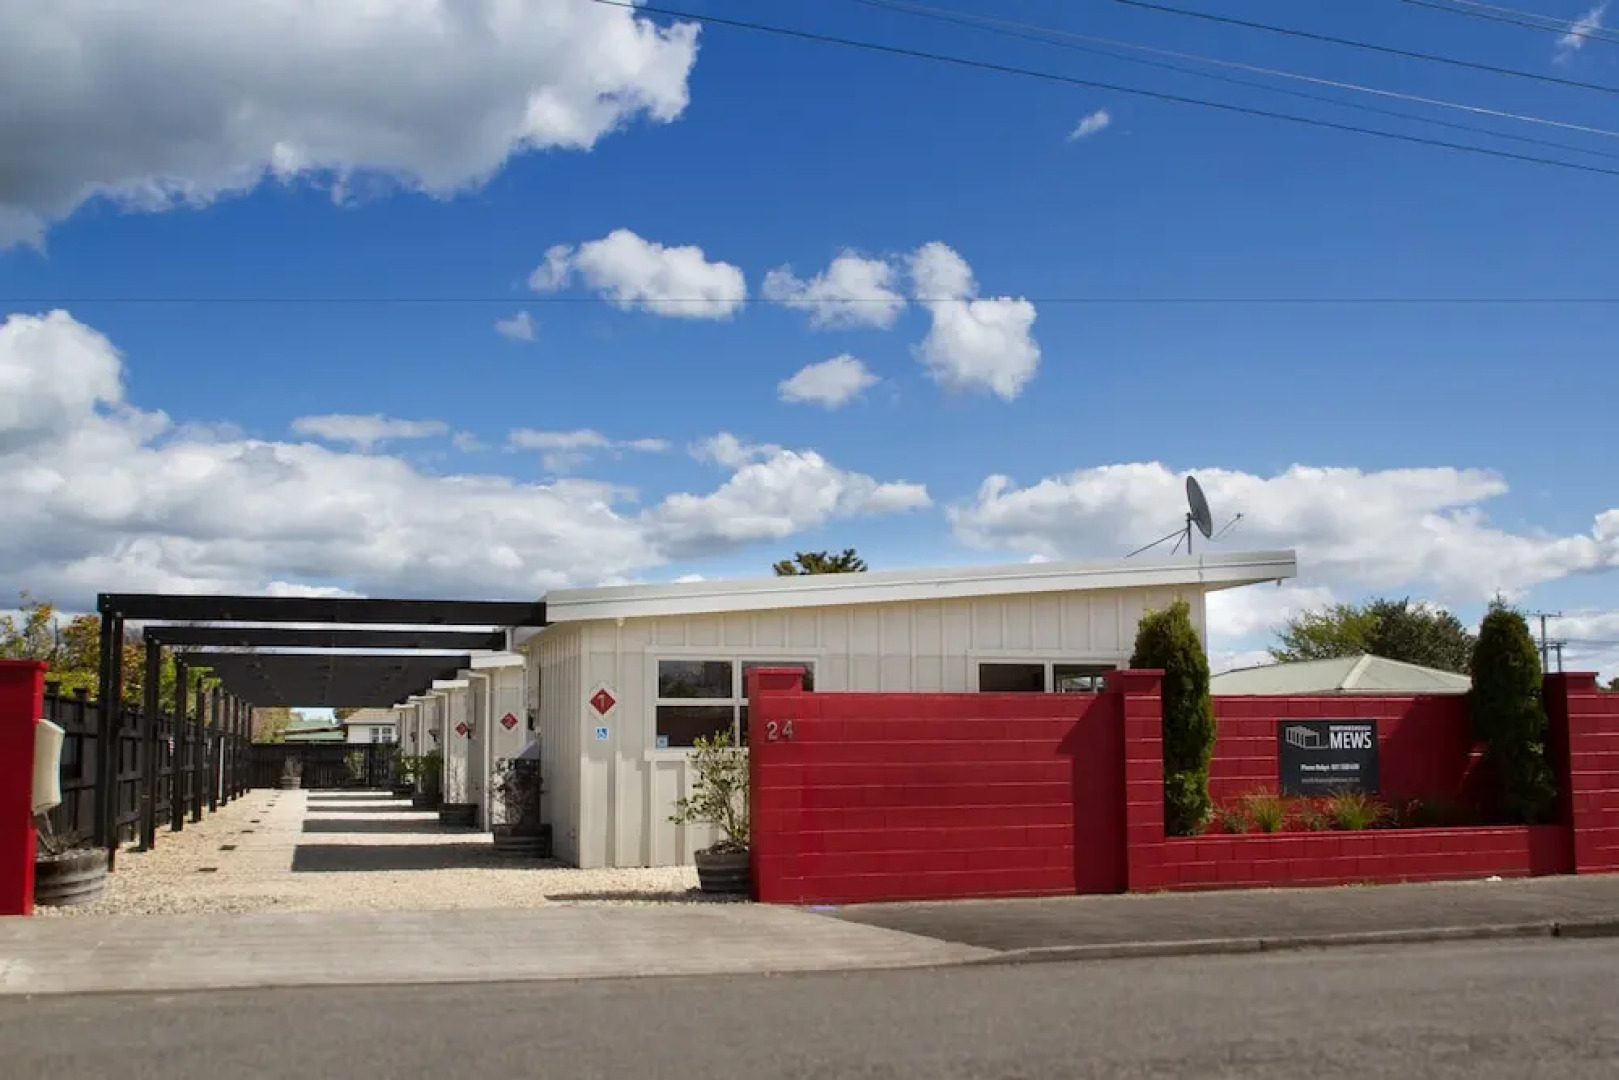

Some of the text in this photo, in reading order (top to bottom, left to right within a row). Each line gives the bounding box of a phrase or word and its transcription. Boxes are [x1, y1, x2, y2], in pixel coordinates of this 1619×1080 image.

[598, 694, 606, 709] 1
[766, 720, 793, 740] 24
[1330, 731, 1372, 749] MEWS
